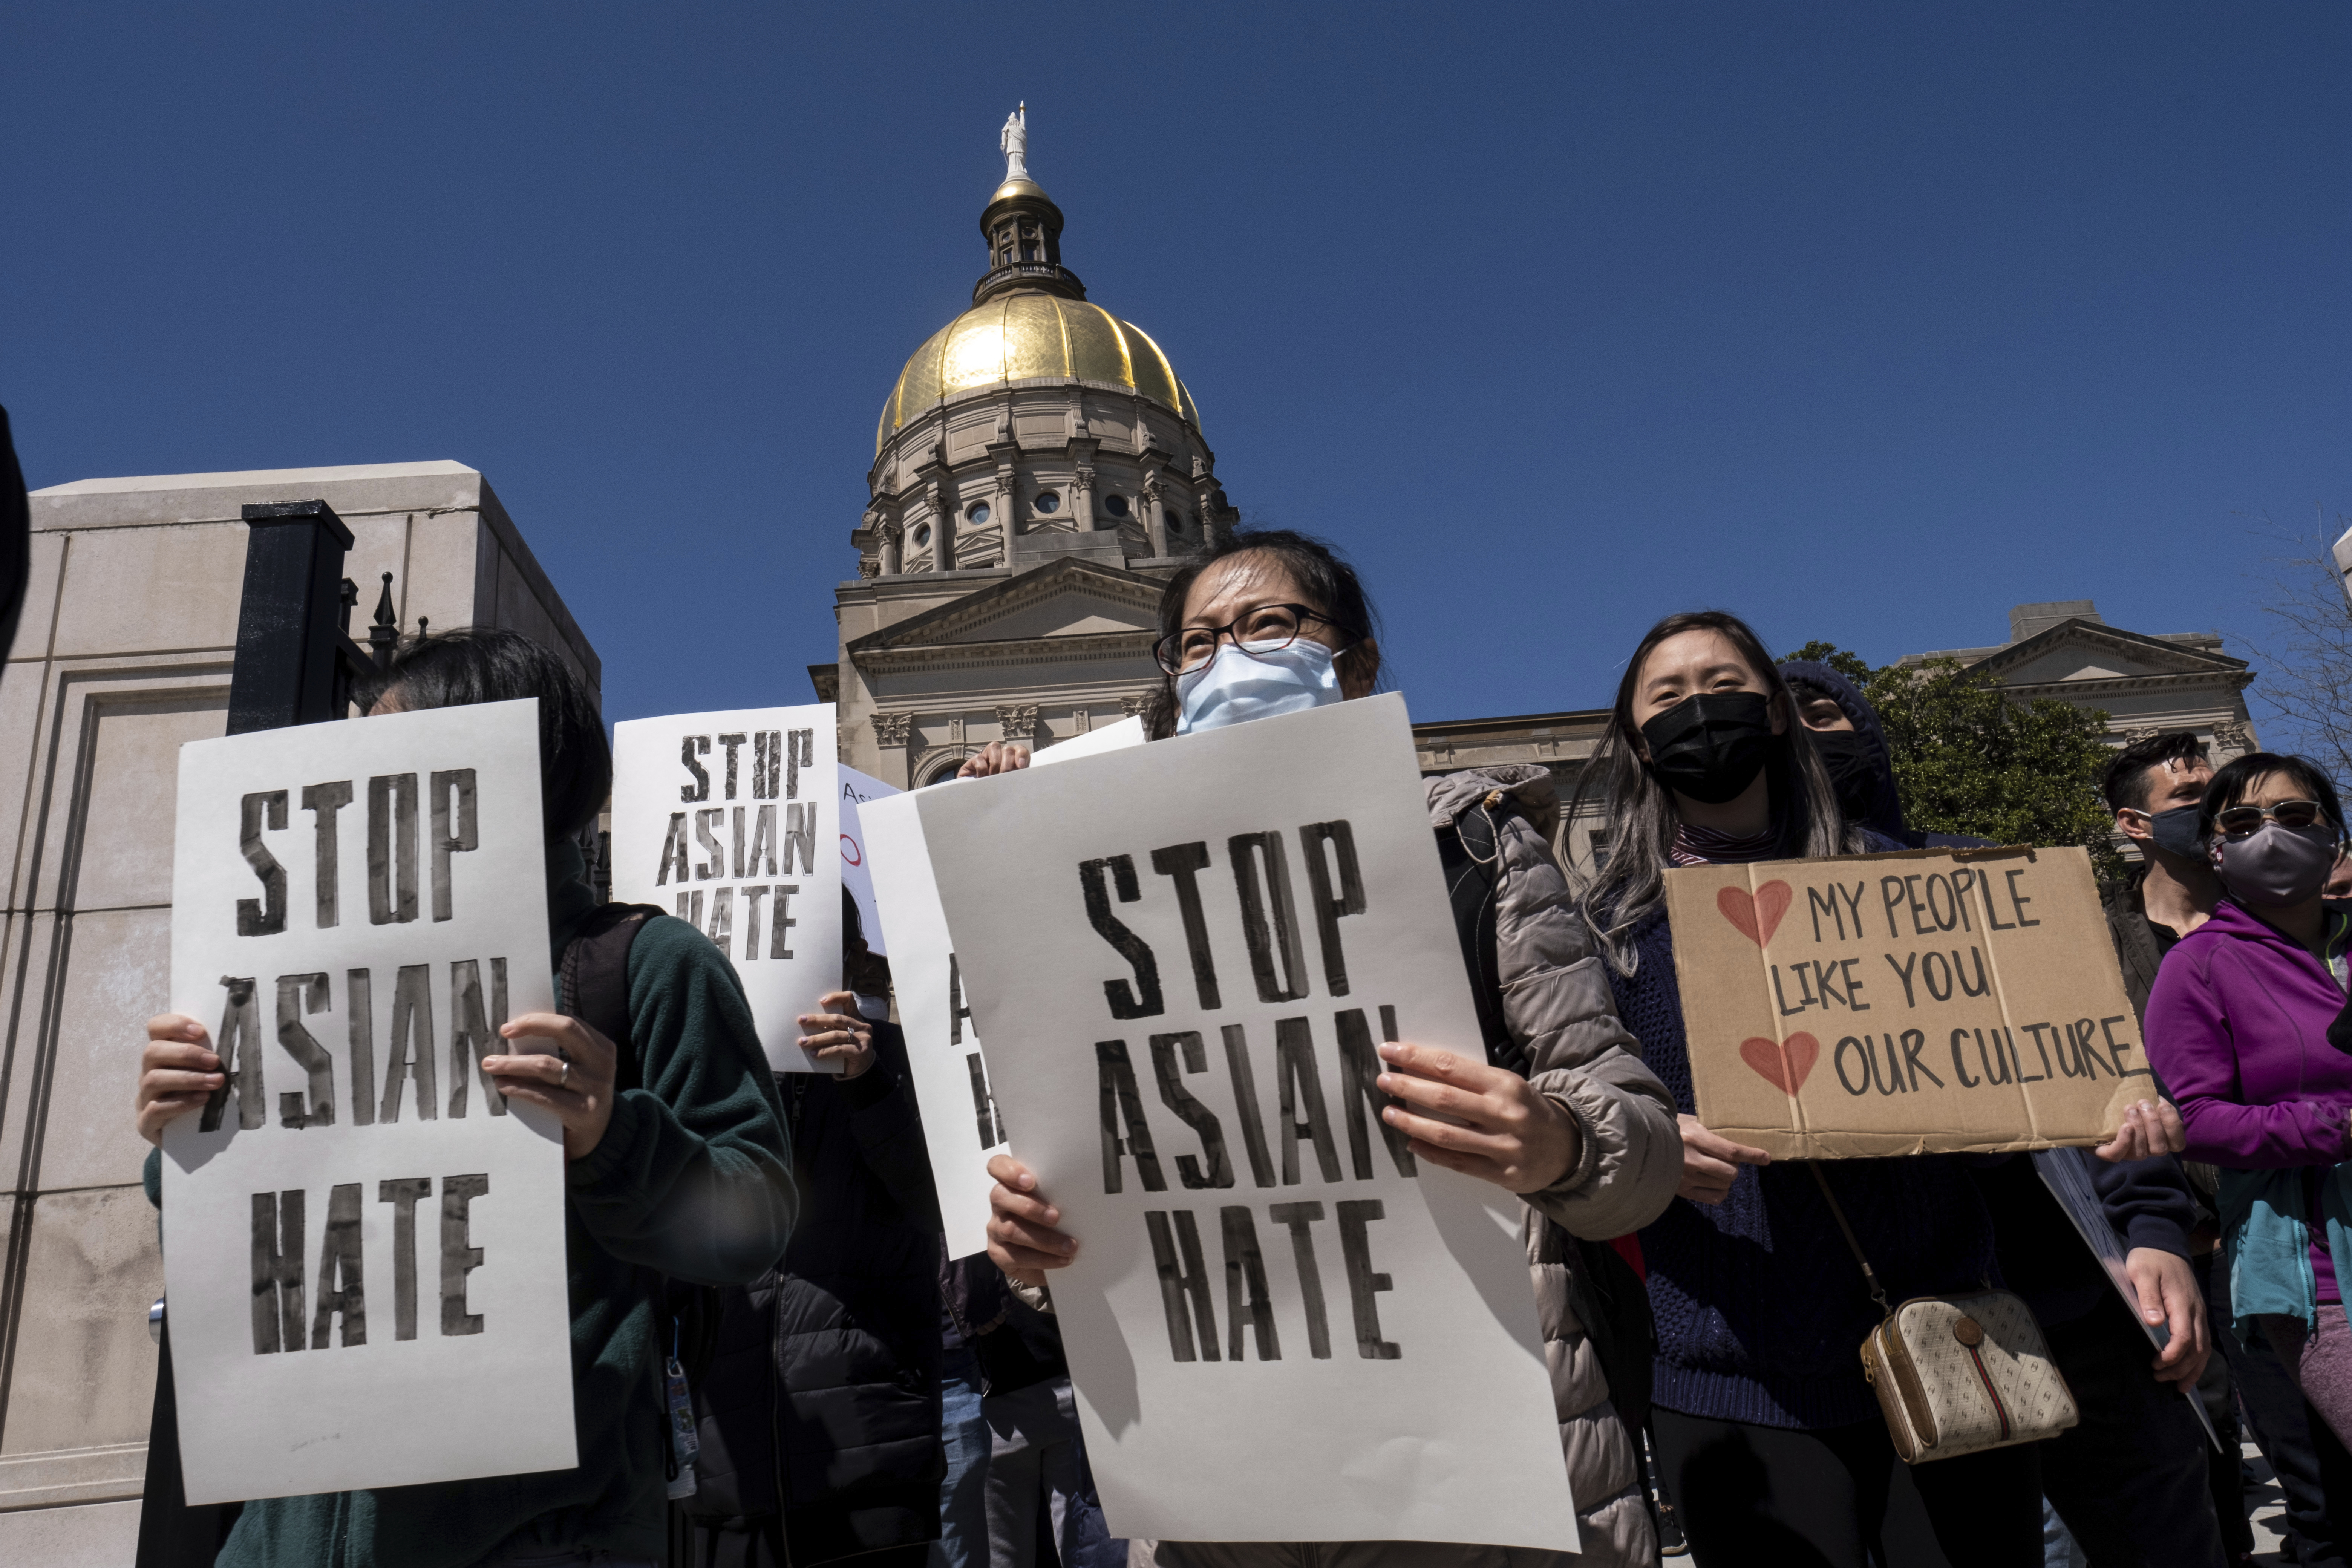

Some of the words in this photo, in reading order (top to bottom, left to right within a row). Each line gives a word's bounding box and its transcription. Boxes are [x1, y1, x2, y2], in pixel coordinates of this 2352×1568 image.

[656, 802, 817, 886] ASIAN
[681, 728, 813, 803] STOP
[237, 768, 478, 937] STOP
[1078, 819, 1367, 1020] STOP
[1807, 880, 1864, 942] MY
[1880, 868, 2040, 939] PEOPLE
[198, 957, 507, 1133] ASIAN
[1771, 958, 1870, 1016] LIKE
[1885, 946, 1991, 1008] YOU
[1834, 1028, 1944, 1096] OUR
[1951, 1015, 2151, 1089] CULTURE
[1094, 1004, 1419, 1195] ASIAN
[251, 1173, 489, 1355] HATE
[1144, 1199, 1403, 1362] HATE
